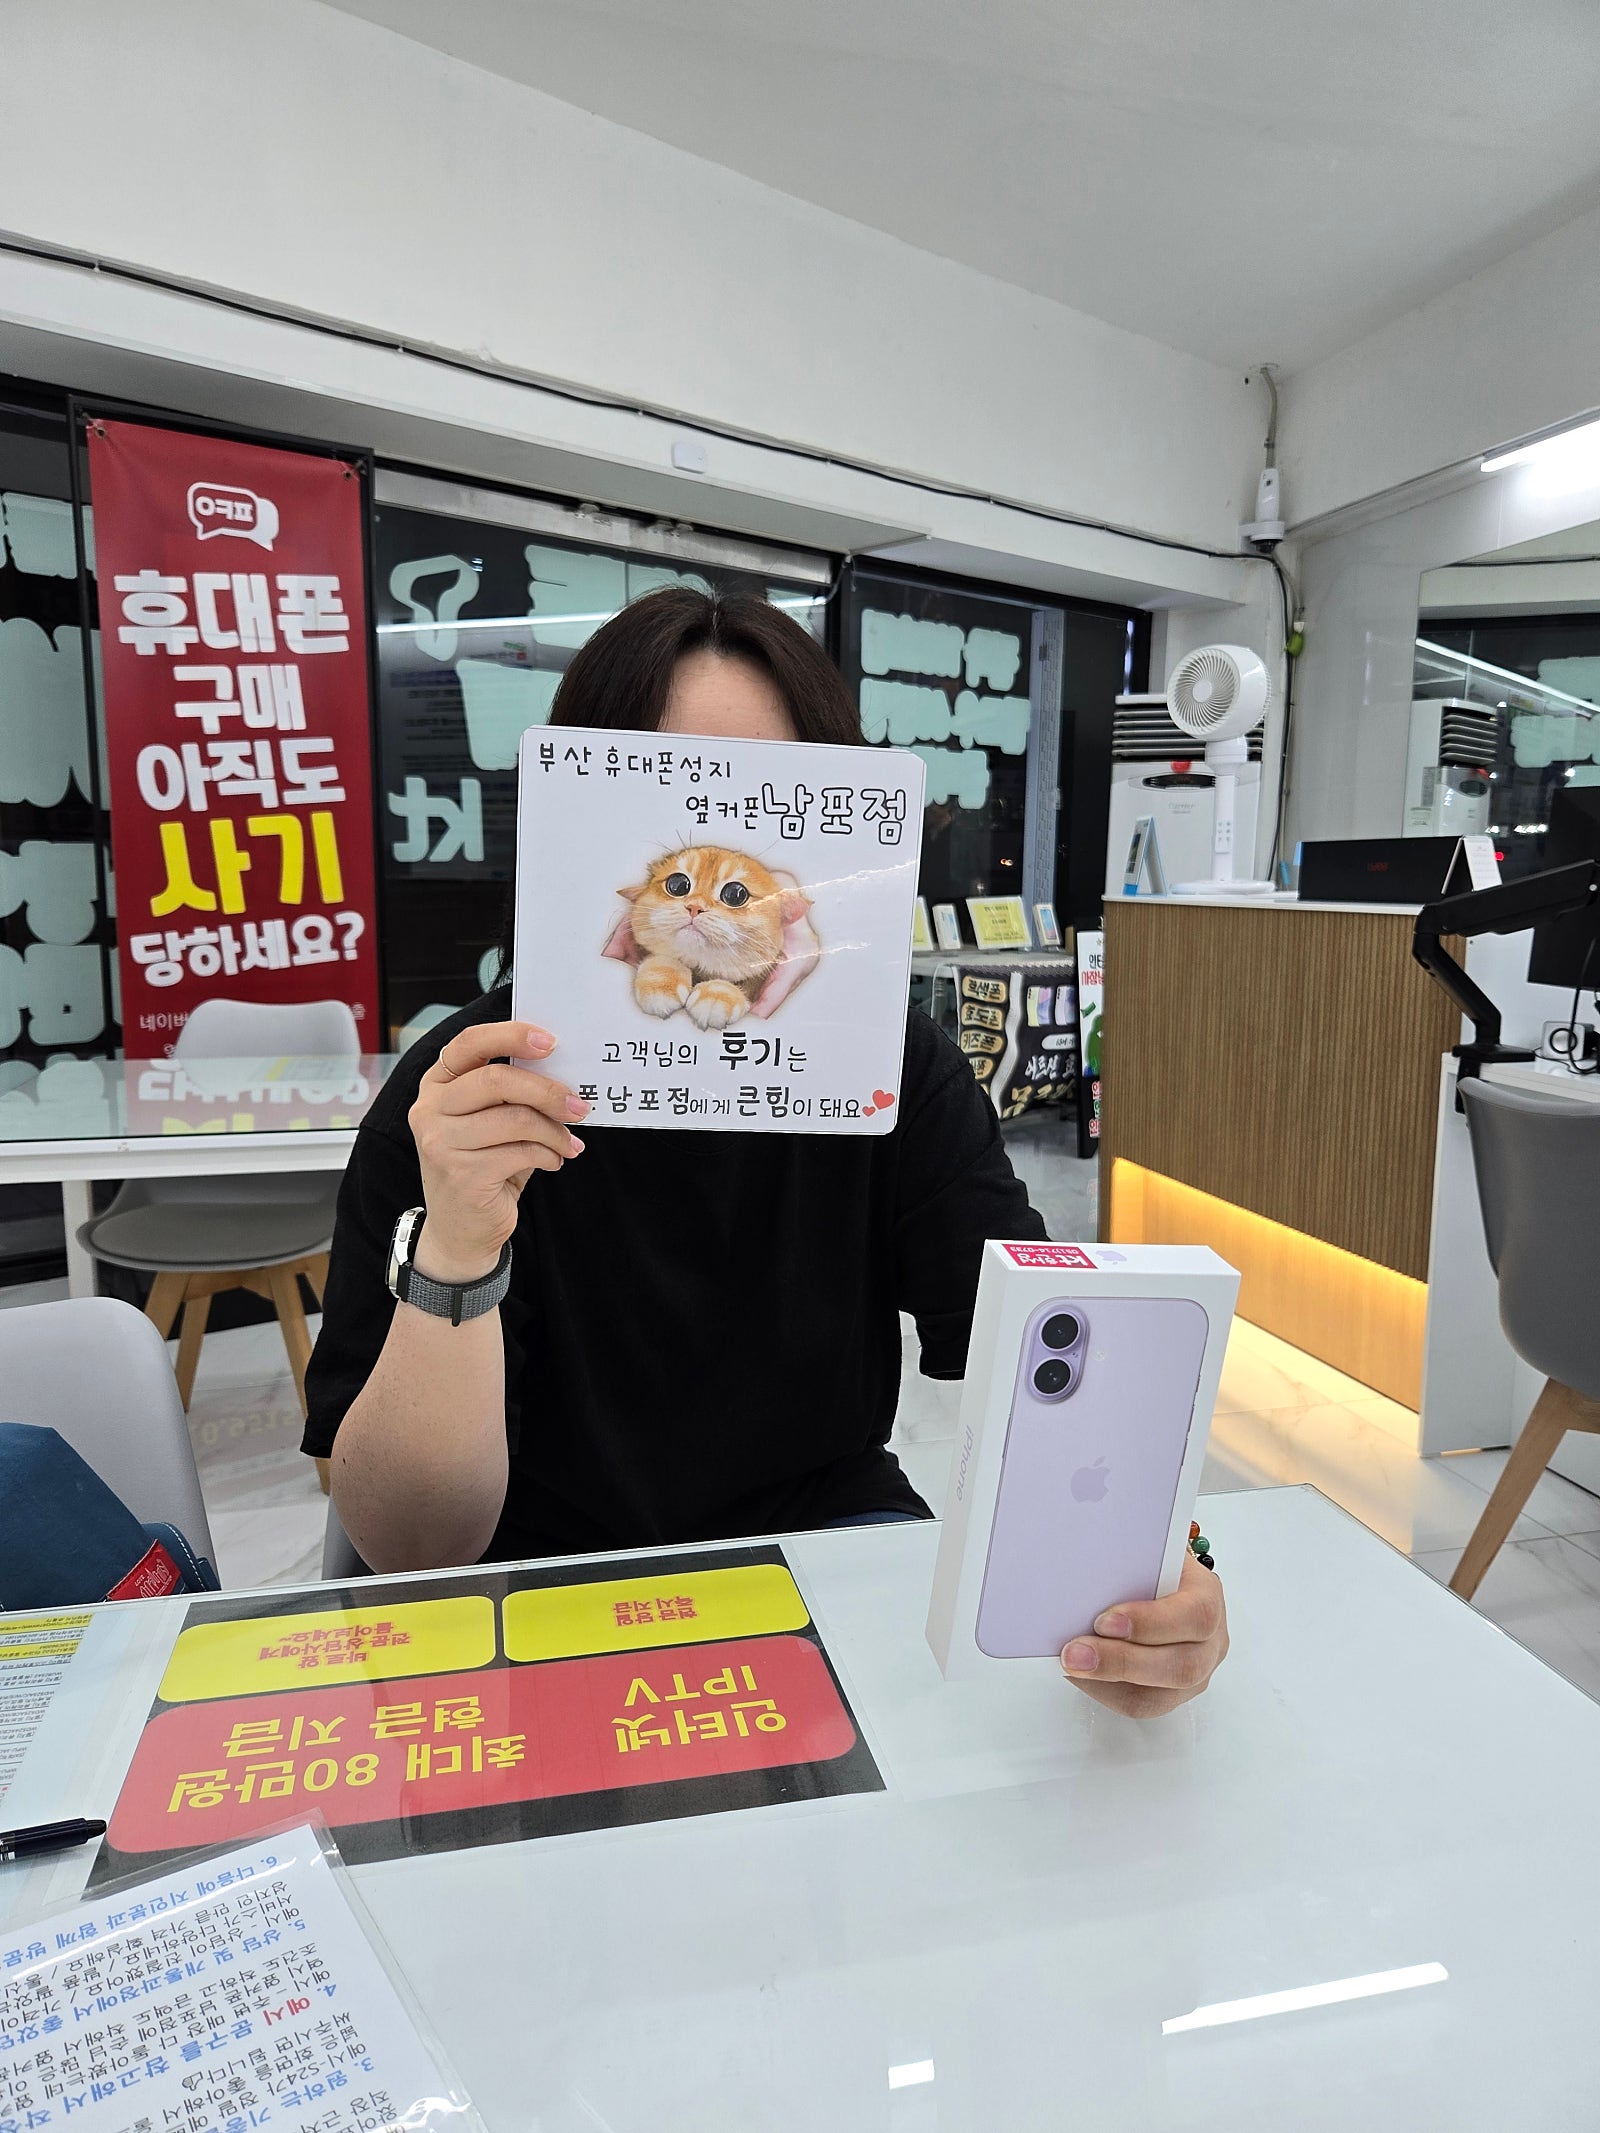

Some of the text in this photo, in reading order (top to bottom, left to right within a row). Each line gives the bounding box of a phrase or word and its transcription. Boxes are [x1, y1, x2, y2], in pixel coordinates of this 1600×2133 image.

[113, 568, 350, 657] 휴대폰
[174, 663, 307, 735] 구매
[136, 737, 346, 812] 아직도
[539, 743, 732, 785] 부산 휴대폰성지
[761, 782, 907, 845] 남포점
[150, 810, 346, 918] 사기
[130, 911, 366, 987] 당하세요?
[602, 1031, 807, 1073] 고객님의 후기는
[818, 1098, 862, 1118] 돼요
[956, 1424, 974, 1502] iPhone
[613, 1595, 694, 1614] 즉시 지급
[616, 1608, 697, 1627] 현금 당일
[370, 1633, 411, 1648] 전문
[325, 1651, 367, 1665] 바로
[624, 1665, 758, 1707] IPTV
[222, 1695, 485, 1758] 현금 지급
[611, 1699, 787, 1753] 인터넷
[166, 1734, 526, 1813] 최대 80만원
[260, 1856, 276, 1867] 6.
[196, 1866, 254, 1895] 다음에
[236, 1881, 286, 1908] 성지인
[106, 1891, 187, 1928] 지인분과
[194, 1902, 229, 1924] 만큼
[224, 1894, 291, 1927] 서비스가
[264, 1907, 299, 1927] 예시
[287, 1918, 305, 1930] 5.
[55, 1922, 97, 1948] 함께
[123, 1924, 215, 1964] 다양하네요
[151, 1920, 186, 1941] 가격
[190, 1927, 242, 1956] 상담이
[242, 1929, 280, 1952] 상담
[66, 1937, 142, 1971] 확실해요
[213, 1947, 233, 1964] 및
[262, 1942, 316, 1971] 조건도
[287, 1958, 323, 1978] 역시
[62, 1966, 100, 1990] 발품
[85, 1952, 181, 1995] 친절했어요
[199, 1970, 255, 1997] 착하고
[224, 1973, 279, 2004] 옆커폰
[293, 1970, 329, 1992] 예시
[74, 1961, 203, 2020] 개통과정에서
[316, 1984, 336, 1996] 4.
[0, 2000, 60, 2032] 가격이
[132, 1993, 191, 2024] 금액도
[138, 2000, 216, 2041] 남포점에
[232, 1995, 269, 2018] 주변
[263, 1997, 309, 2025] 예시
[64, 2023, 124, 2055] 착해서
[180, 2019, 251, 2061] 문구를
[187, 2015, 224, 2037] 매장
[320, 2025, 357, 2050] 넓은
[89, 2036, 128, 2062] 손님
[158, 2035, 177, 2050] 다
[207, 2012, 349, 2083] 써주시면 됩니다
[38, 2056, 79, 2081] 많은
[44, 2045, 148, 2098] 돌아봤는데
[255, 2046, 313, 2080] 화면을
[267, 2043, 365, 2095] 예시-S24가
[354, 2057, 373, 2071] 3.
[63, 2056, 168, 2112] 참고해서
[281, 2070, 346, 2107] 원하는
[162, 2076, 245, 2123] 좋아해서
[218, 2091, 258, 2118] 정말
[350, 2091, 388, 2115] 직장
